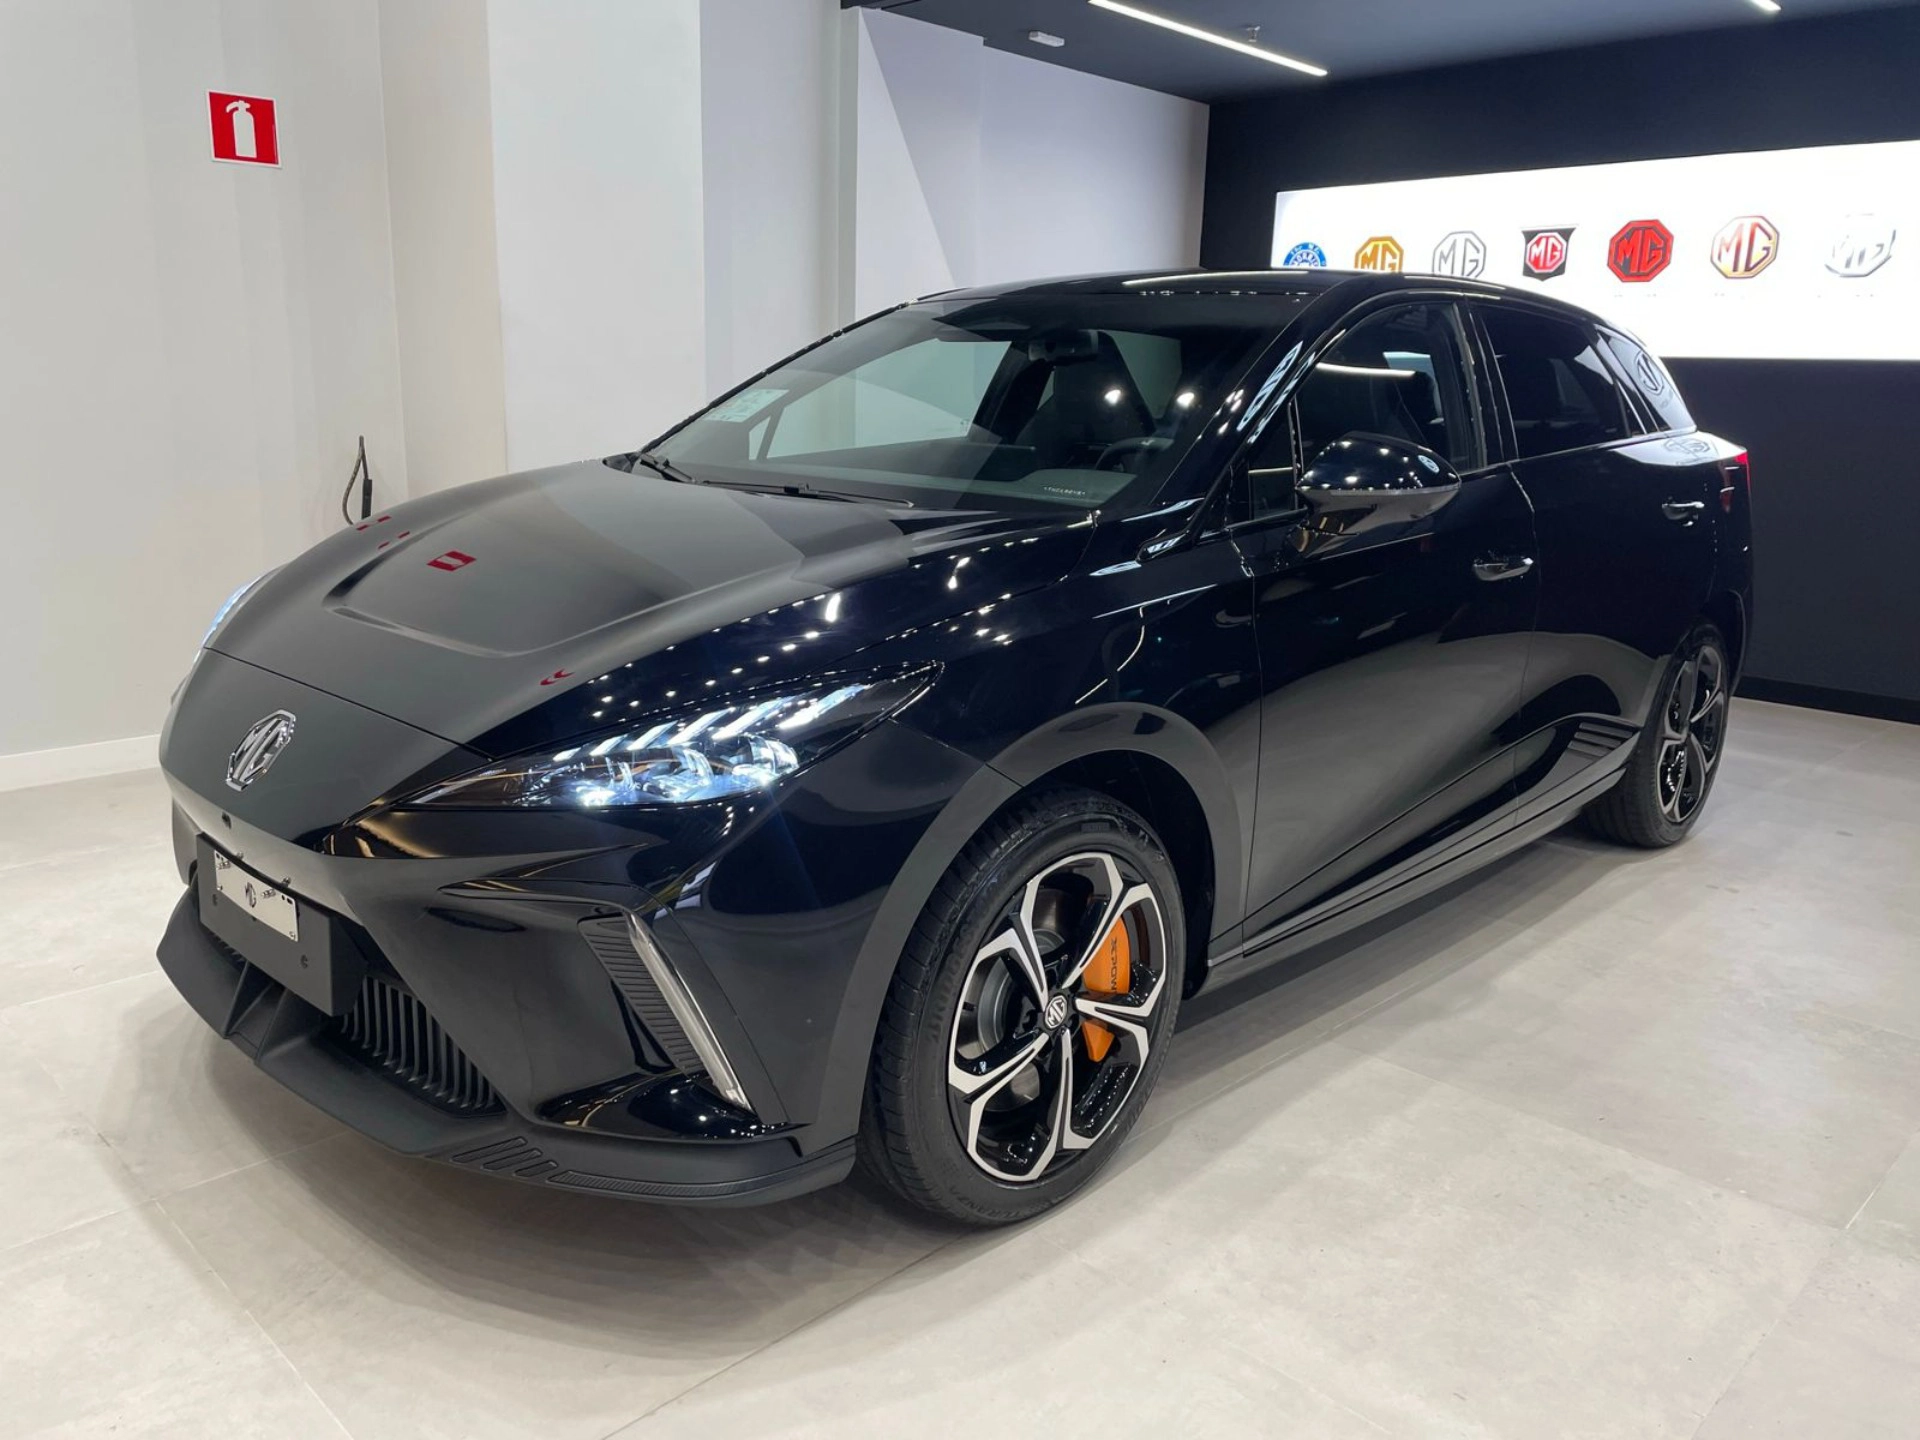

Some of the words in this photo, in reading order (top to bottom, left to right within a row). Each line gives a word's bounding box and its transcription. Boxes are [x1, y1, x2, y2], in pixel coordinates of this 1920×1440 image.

[1360, 242, 1397, 271] MG
[1438, 237, 1480, 276] MG
[1530, 236, 1562, 268] MG
[1616, 229, 1664, 273] MG
[1718, 222, 1771, 272] MG
[231, 718, 289, 783] MG
[1048, 999, 1065, 1026] MG
